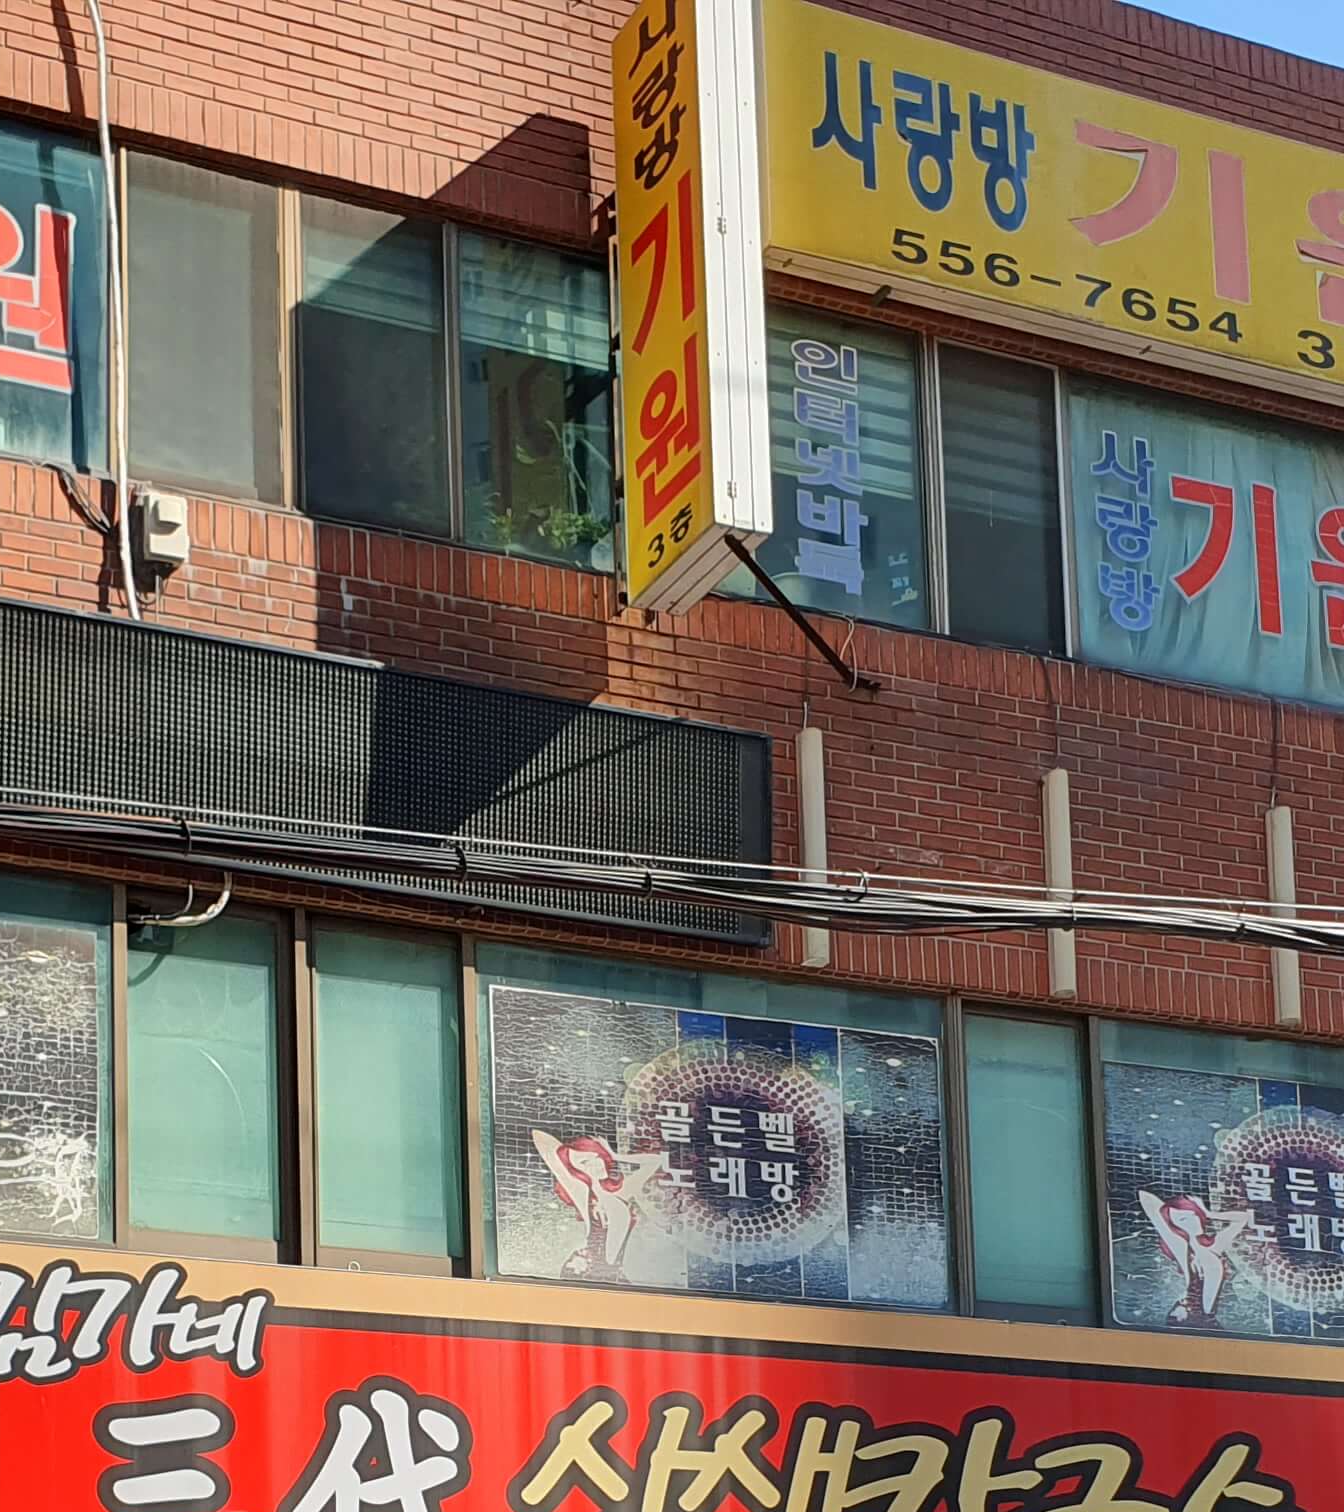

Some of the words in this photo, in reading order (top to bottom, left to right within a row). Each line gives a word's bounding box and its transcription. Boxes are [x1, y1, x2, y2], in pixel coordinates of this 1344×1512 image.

[627, 0, 687, 191] 사랑방
[811, 50, 1037, 234] 사랑방
[629, 168, 702, 530] 기원
[890, 227, 1244, 345] 556-7654
[646, 501, 695, 570] 3층
[1091, 429, 1159, 634] 사랑방
[654, 1100, 798, 1154] 골든벨
[656, 1155, 800, 1203] 노래방
